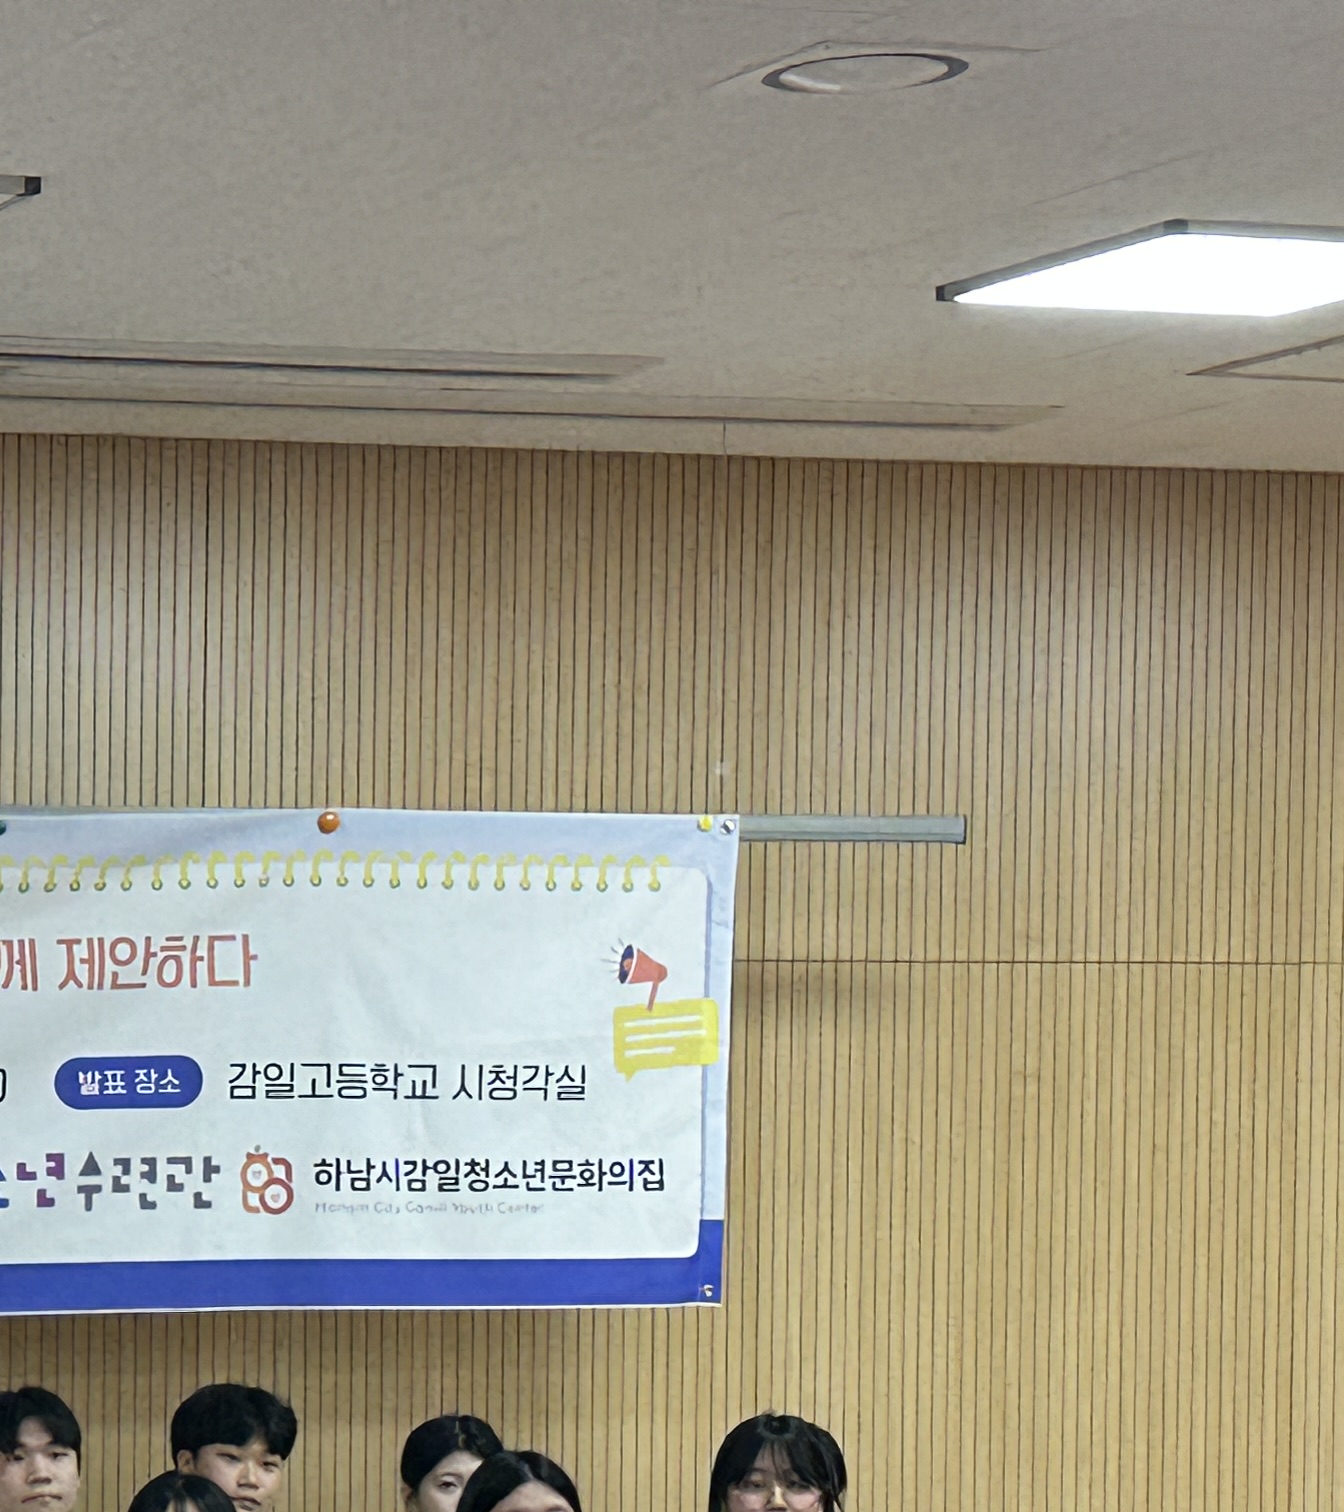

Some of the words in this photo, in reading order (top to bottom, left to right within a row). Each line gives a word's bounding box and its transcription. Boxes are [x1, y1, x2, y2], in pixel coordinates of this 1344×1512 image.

[56, 934, 258, 990] 제안하다
[79, 1071, 127, 1095] 발표
[135, 1069, 180, 1093] 장소
[229, 1063, 439, 1100] 감일고등학교
[452, 1064, 585, 1101] 시청각실
[313, 1158, 664, 1192] 하남시감일청소년문화의집
